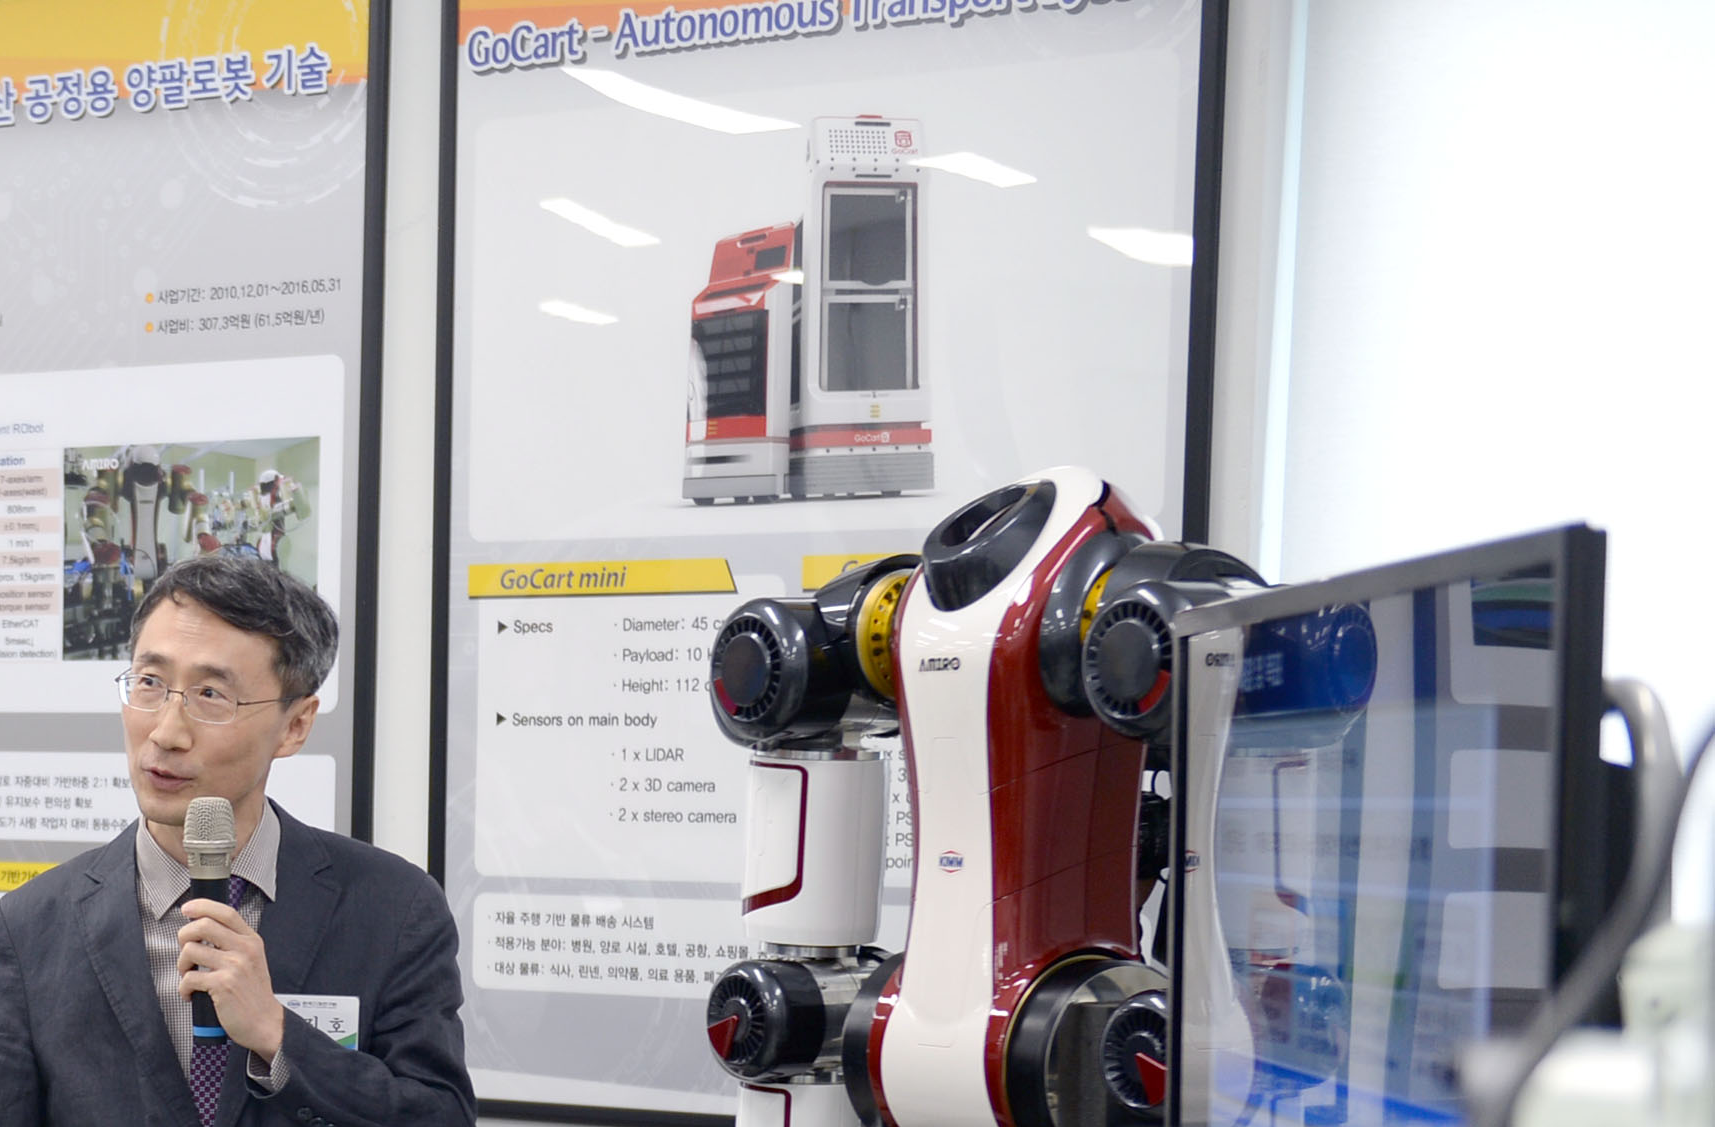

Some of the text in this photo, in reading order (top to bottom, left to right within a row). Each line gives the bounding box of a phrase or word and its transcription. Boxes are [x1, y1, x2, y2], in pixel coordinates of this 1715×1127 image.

[468, 24, 579, 67] GoCart
[616, 0, 835, 50] Autonomous
[25, 69, 114, 120] 공정용
[127, 55, 252, 108] 양팔로봇
[265, 46, 328, 91] 기술
[158, 278, 342, 304] 사업기간: 2010.12.01~2016.05.31
[158, 308, 325, 335] 사업비: 307.3억원 (61.5억원/년)
[500, 566, 627, 590] GoCart mini
[2, 619, 39, 629] EtherCAT
[513, 620, 554, 636] Specs
[623, 617, 685, 632] Diameter:
[691, 616, 708, 631] 45
[622, 648, 679, 665] Payload:
[686, 647, 702, 661] 10
[621, 679, 669, 695] Height:
[675, 678, 700, 693] 112
[512, 712, 658, 728] Sensors on main body
[633, 751, 641, 761] x
[645, 748, 684, 762] LIDAR
[15, 775, 50, 788] 자중대비
[54, 776, 90, 789] 가반하중
[619, 778, 716, 793] 2 x 3D camera
[5, 796, 41, 808] 유지보수
[45, 797, 71, 809] 편의성
[75, 797, 93, 809] 확보
[19, 817, 37, 829] 사람
[41, 817, 68, 830] 작업자
[71, 818, 89, 830] 대비
[618, 808, 737, 823] 2 x stereo camera
[494, 910, 655, 931] 자율 주행 기반 물류 배송 시스템
[495, 935, 536, 952] 적용가능
[540, 937, 566, 953] 분야:
[571, 938, 595, 955] 병원,
[599, 939, 621, 955] 양로
[626, 940, 651, 957] 시설,
[655, 941, 680, 958] 호텔,
[685, 943, 710, 959] 공항,
[715, 944, 752, 961] 쇼핑몰,
[494, 961, 516, 977] 대상
[519, 961, 545, 977] 물류:
[550, 963, 574, 979] 식사,
[578, 964, 603, 981] 린넨,
[607, 966, 643, 982] 의약품,
[647, 967, 669, 983] 의료
[674, 968, 699, 984] 용품,
